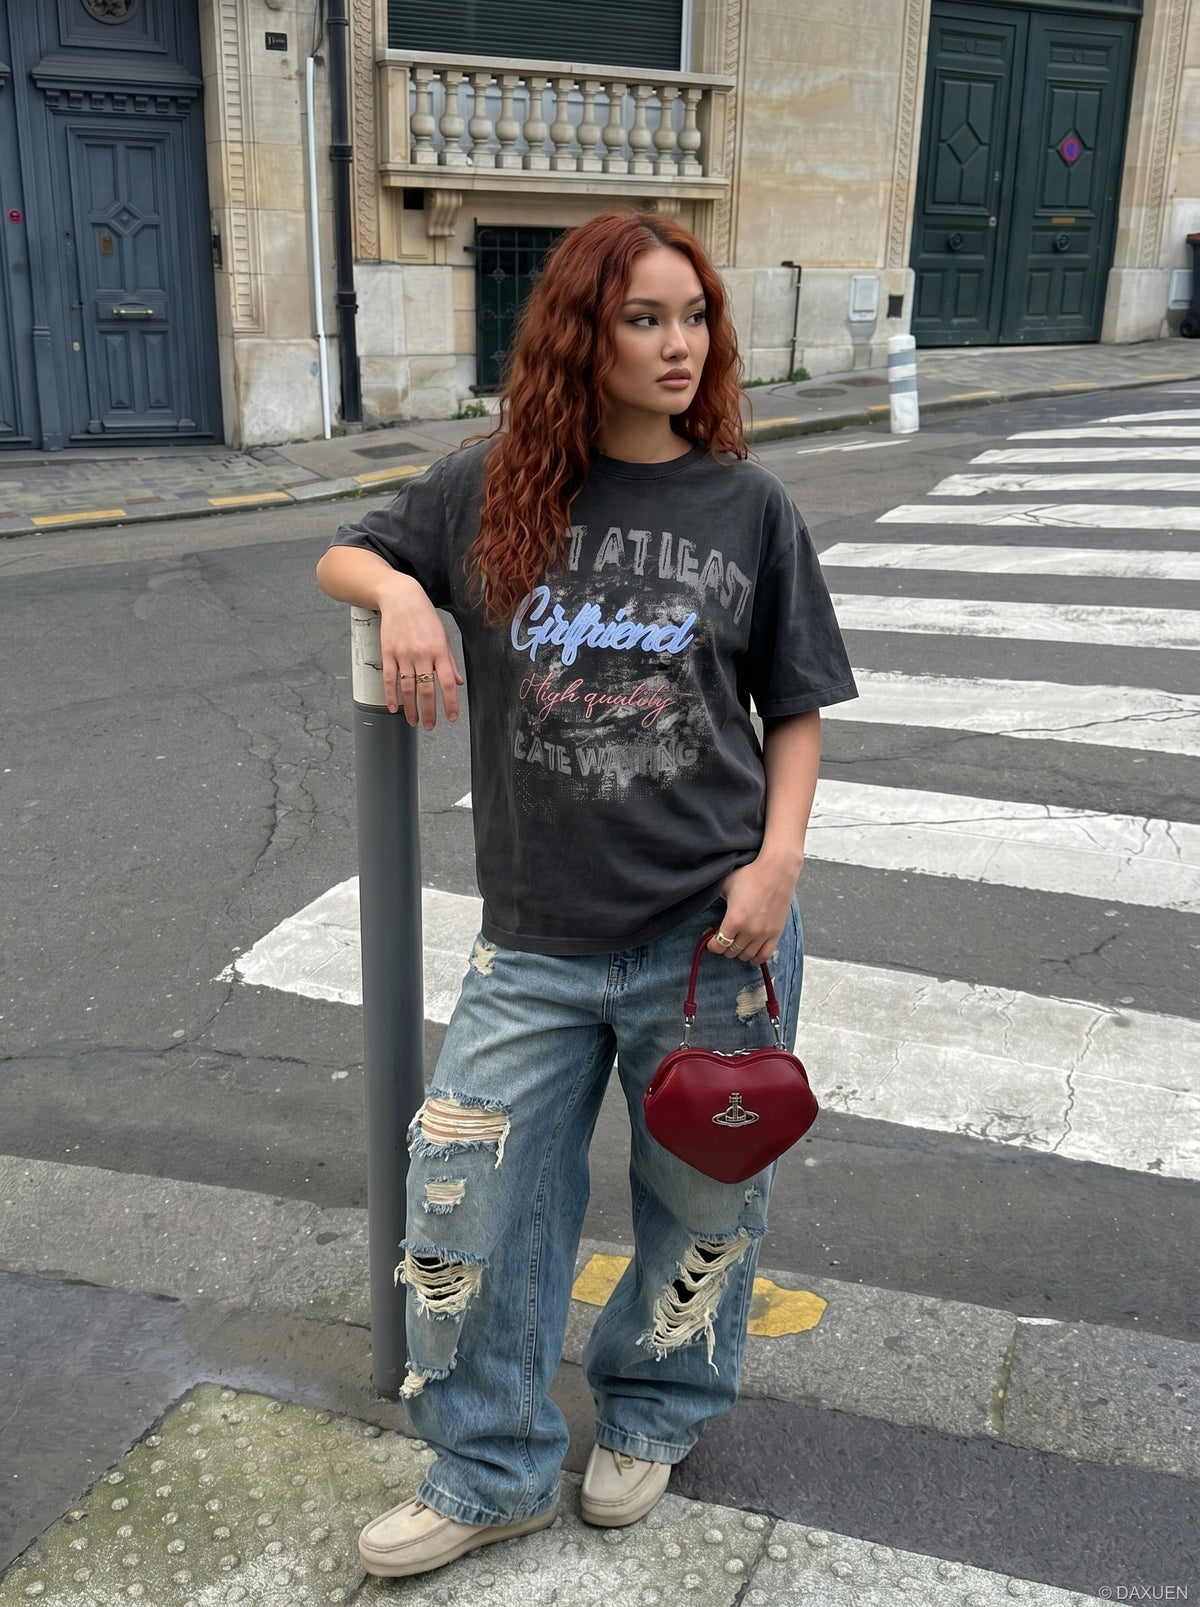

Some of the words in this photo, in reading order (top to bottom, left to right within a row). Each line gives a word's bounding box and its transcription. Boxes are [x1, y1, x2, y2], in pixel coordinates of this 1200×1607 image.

[593, 526, 652, 573] AT
[658, 531, 752, 626] LEAST
[511, 585, 697, 666] Girlfriend
[519, 671, 584, 722] High
[584, 682, 694, 728] quality
